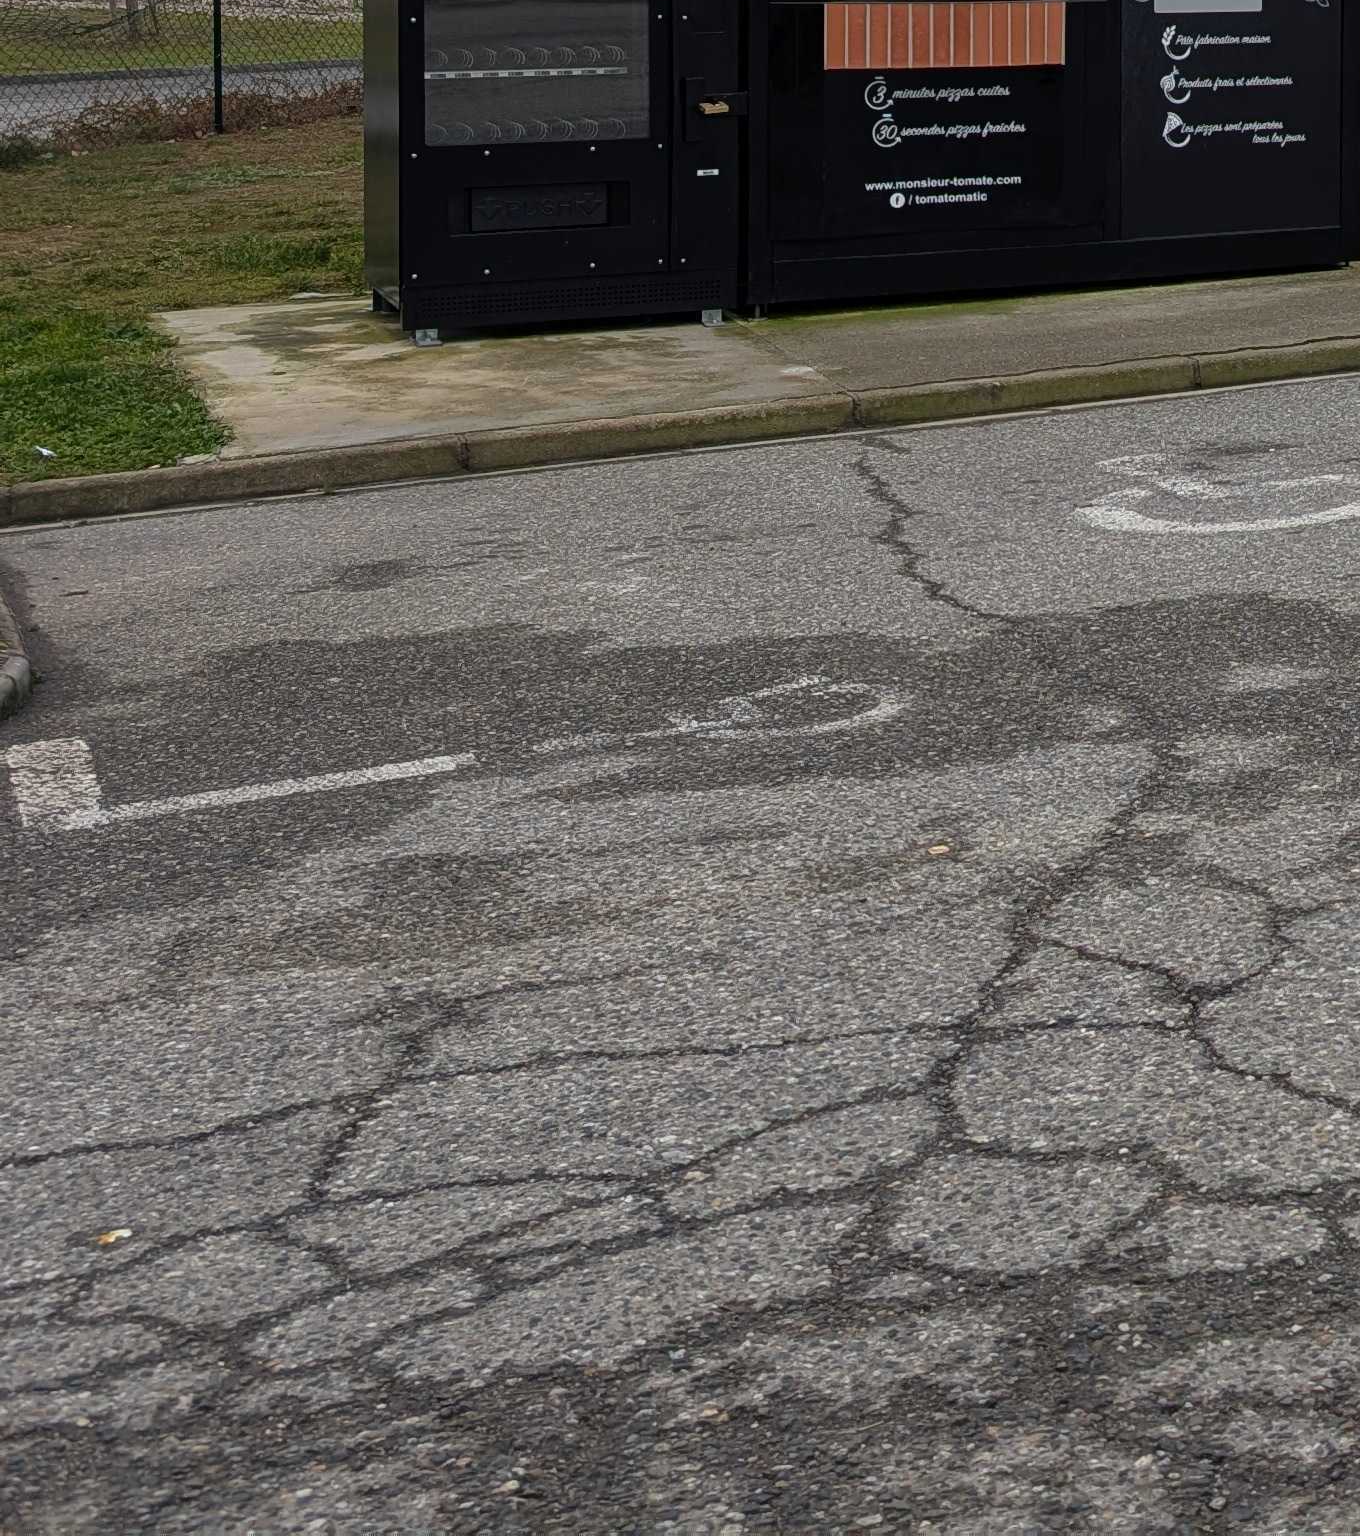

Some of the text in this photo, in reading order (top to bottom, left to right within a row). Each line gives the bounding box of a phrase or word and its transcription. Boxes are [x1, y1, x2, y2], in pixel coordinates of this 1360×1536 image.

[1178, 77, 1212, 88] Produits
[1236, 76, 1245, 86] et
[872, 84, 1010, 105] 3 minutes pizzas cuites
[876, 124, 898, 141] 30
[900, 123, 945, 138] secondes
[946, 122, 981, 138] pizzas
[865, 174, 1022, 192] www.monsieur-tomate.com
[915, 191, 988, 205] tomatomatic
